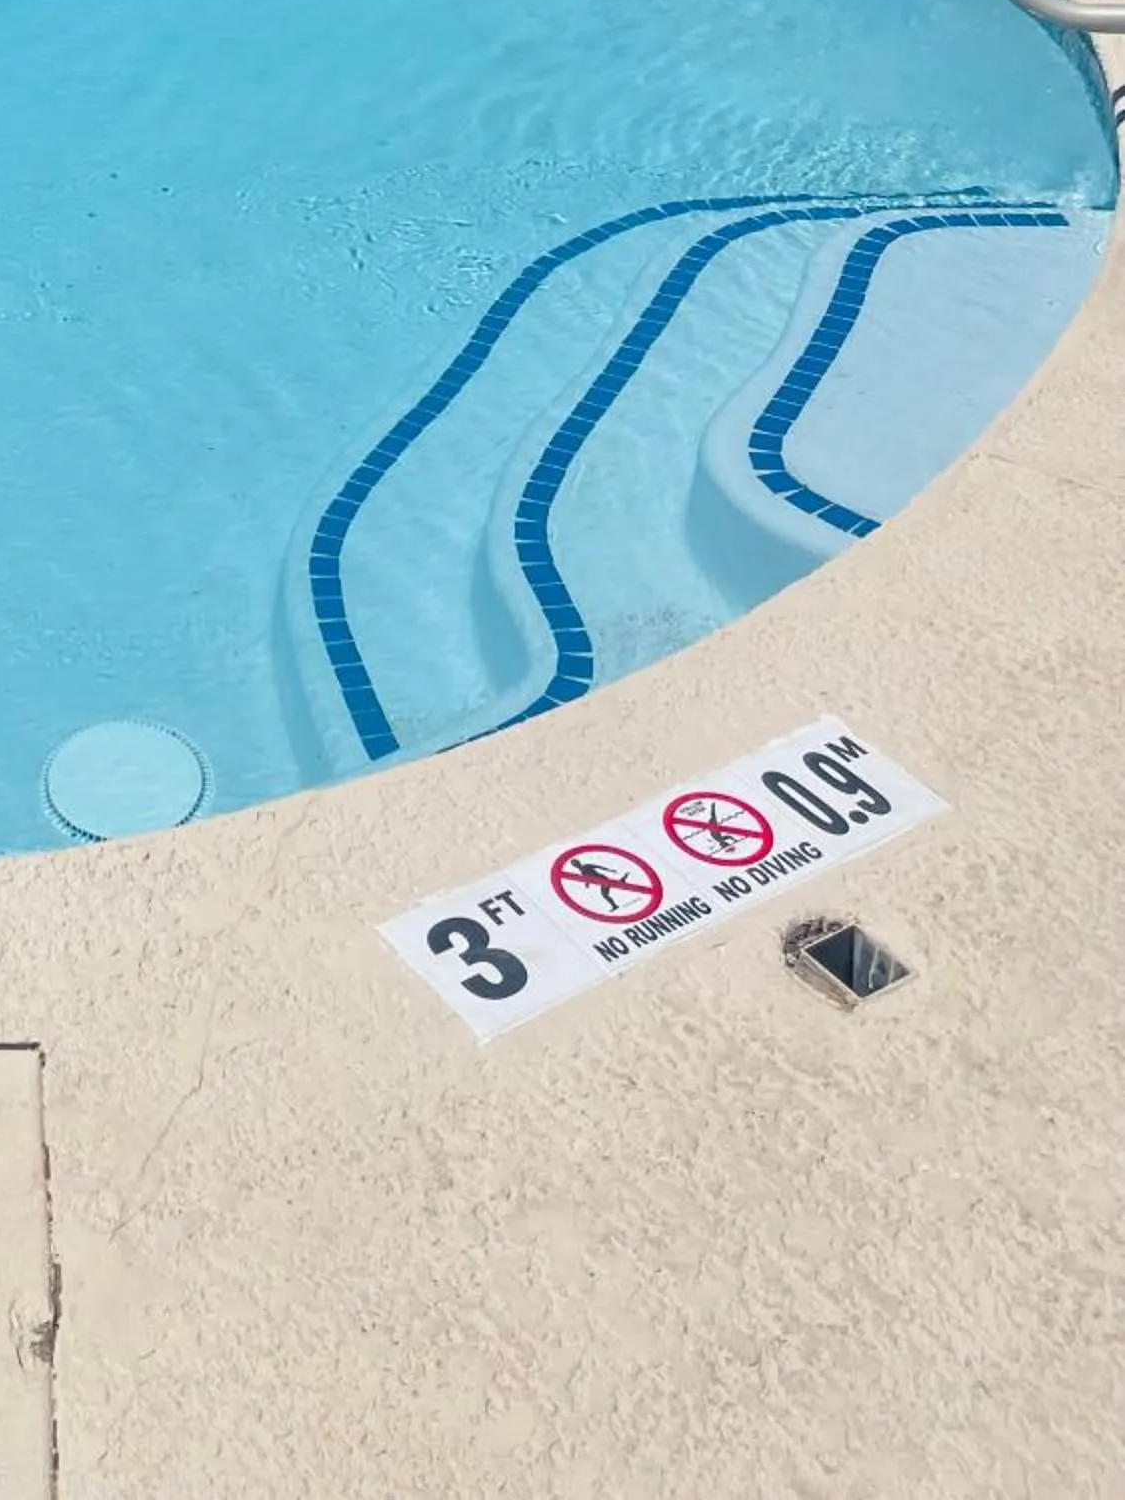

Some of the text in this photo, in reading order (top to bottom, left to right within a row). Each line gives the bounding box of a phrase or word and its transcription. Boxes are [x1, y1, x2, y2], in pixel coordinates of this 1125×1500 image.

[426, 735, 893, 1000] 3 FT 0.9 M
[712, 841, 823, 903] NO DIVING
[593, 896, 712, 962] NO RUNNING
